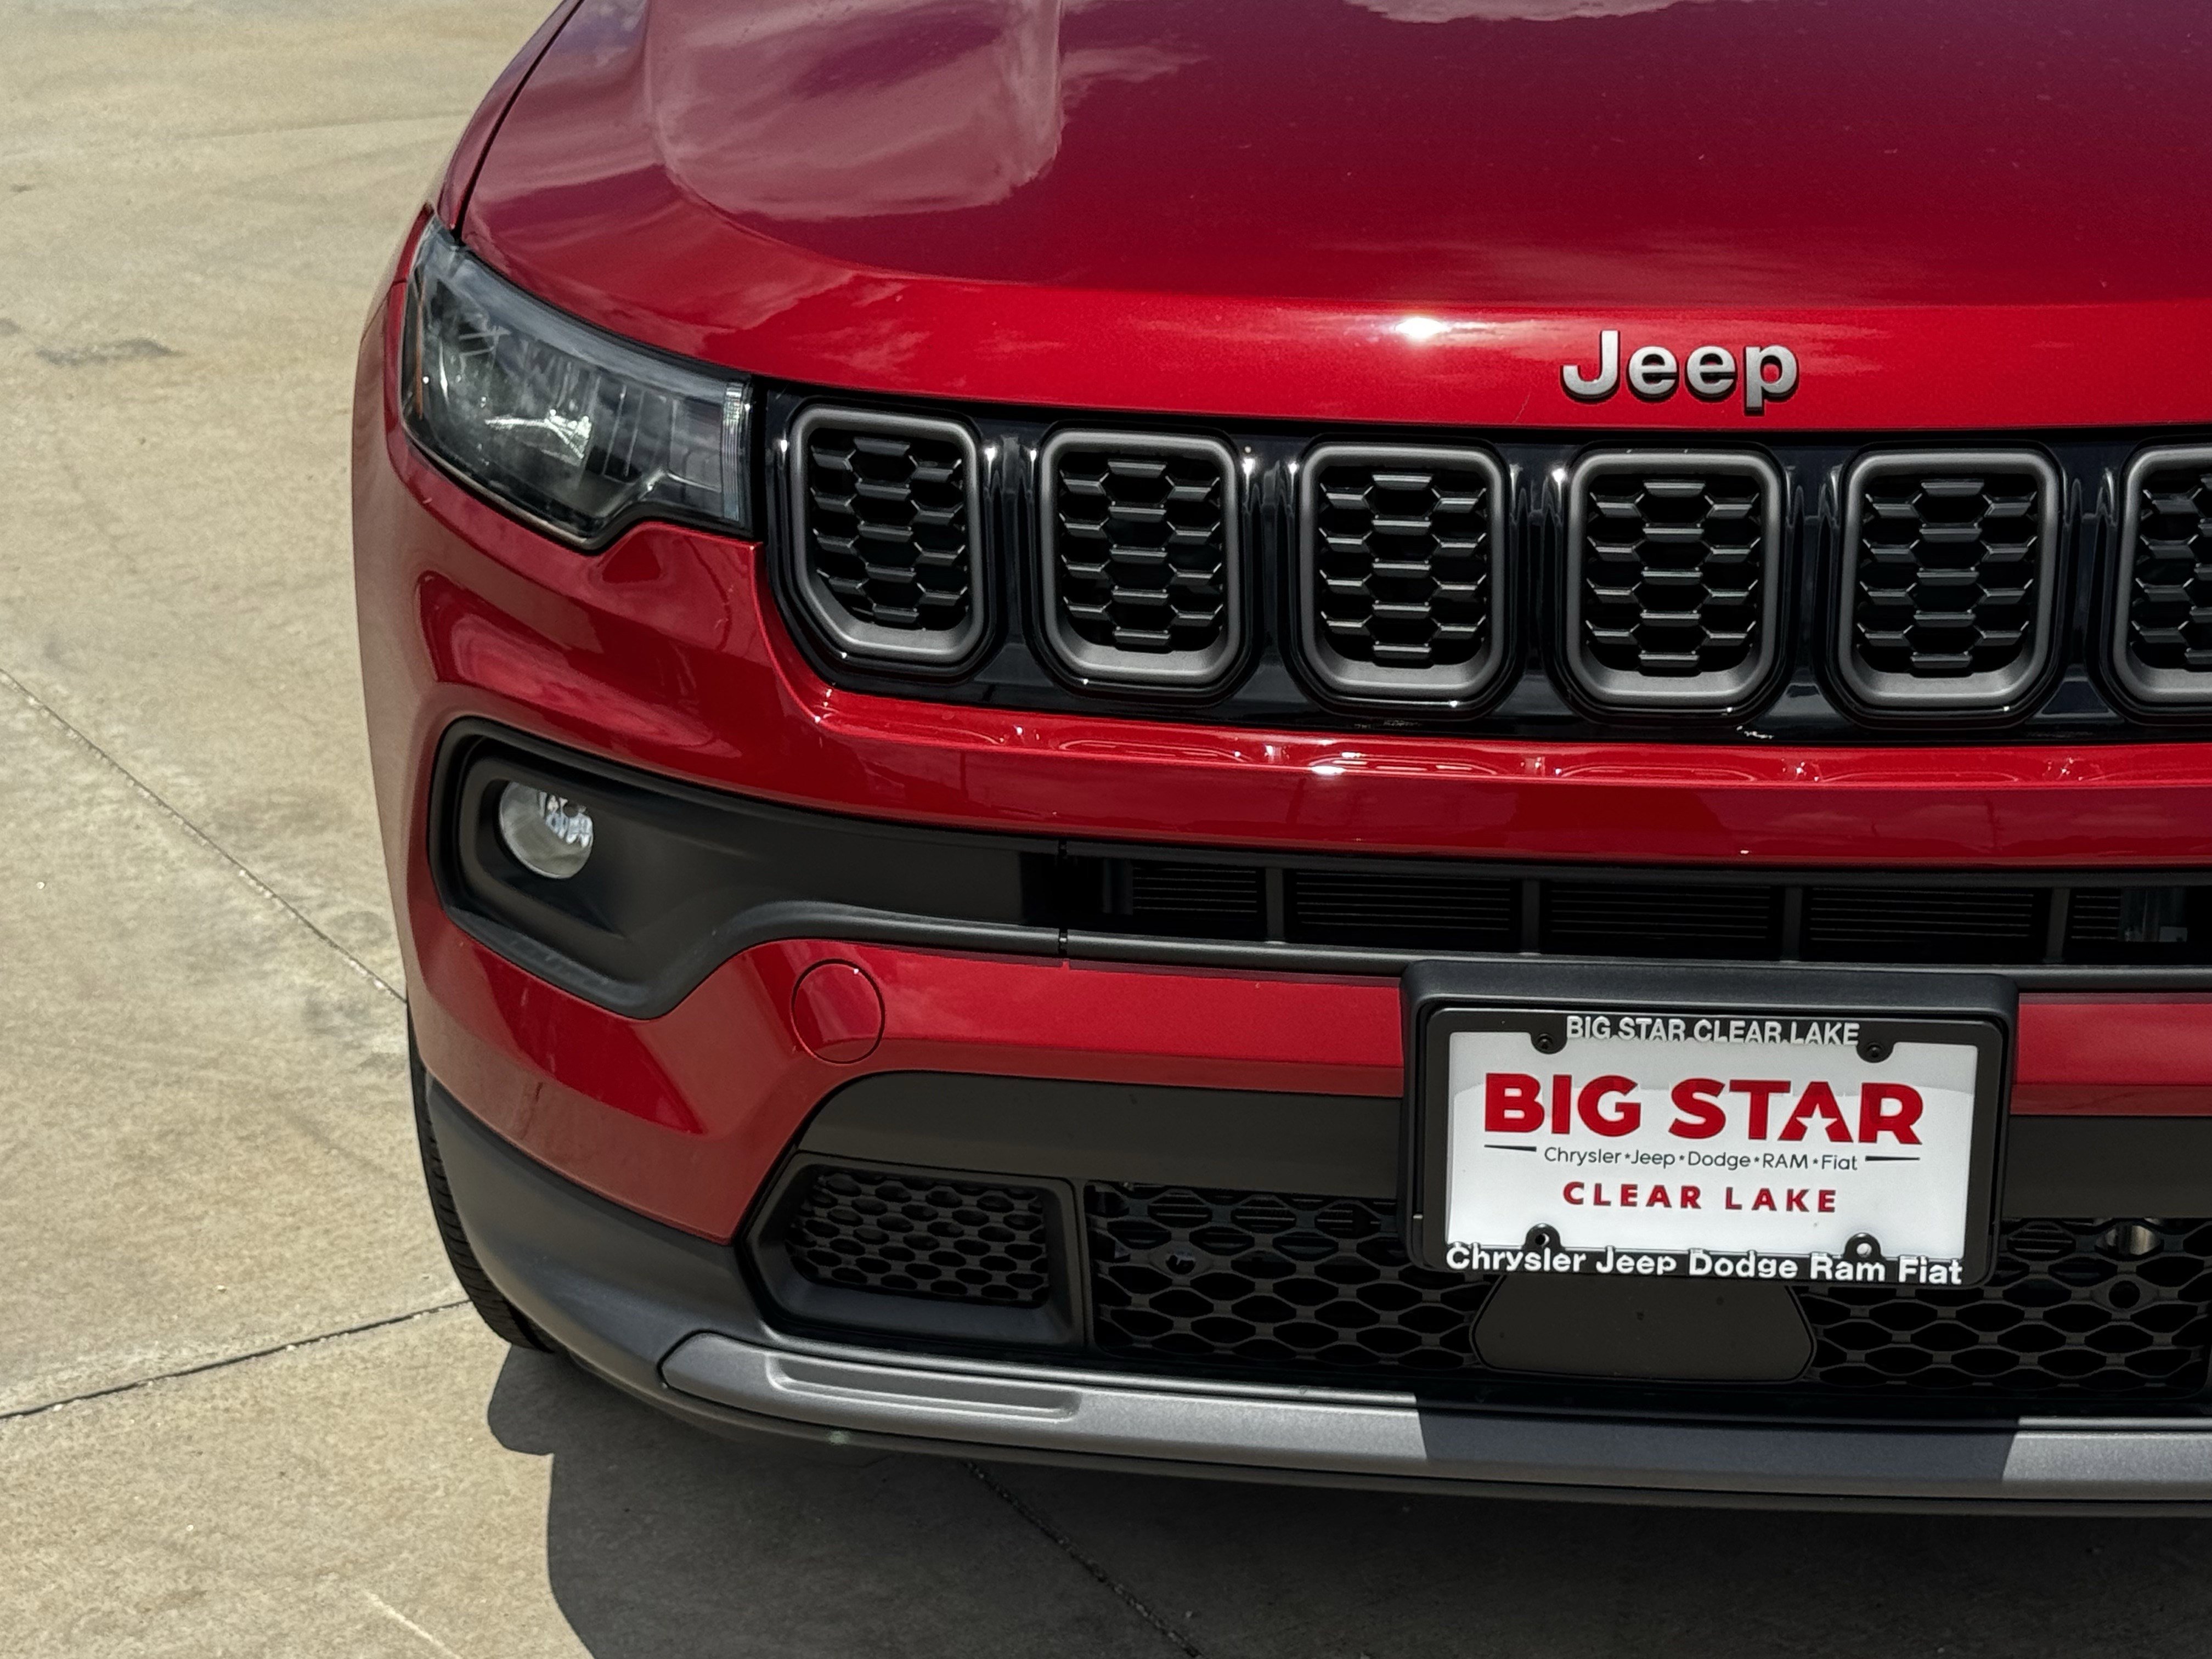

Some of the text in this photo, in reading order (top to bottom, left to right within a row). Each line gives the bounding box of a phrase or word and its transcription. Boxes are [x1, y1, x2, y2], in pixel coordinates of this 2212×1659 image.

[1560, 330, 1799, 416] Jeep
[1566, 1015, 1860, 1046] BIG STAR CLEAR LAKE
[1485, 1073, 1923, 1145] BIG STAR
[1544, 1147, 1858, 1170] Chrysler Jeep Dodge RAM Fiat
[1562, 1181, 1836, 1213] CLEAR LAKE
[1446, 1243, 1963, 1285] Chrysler Jeep Dodge Ram Fiat
